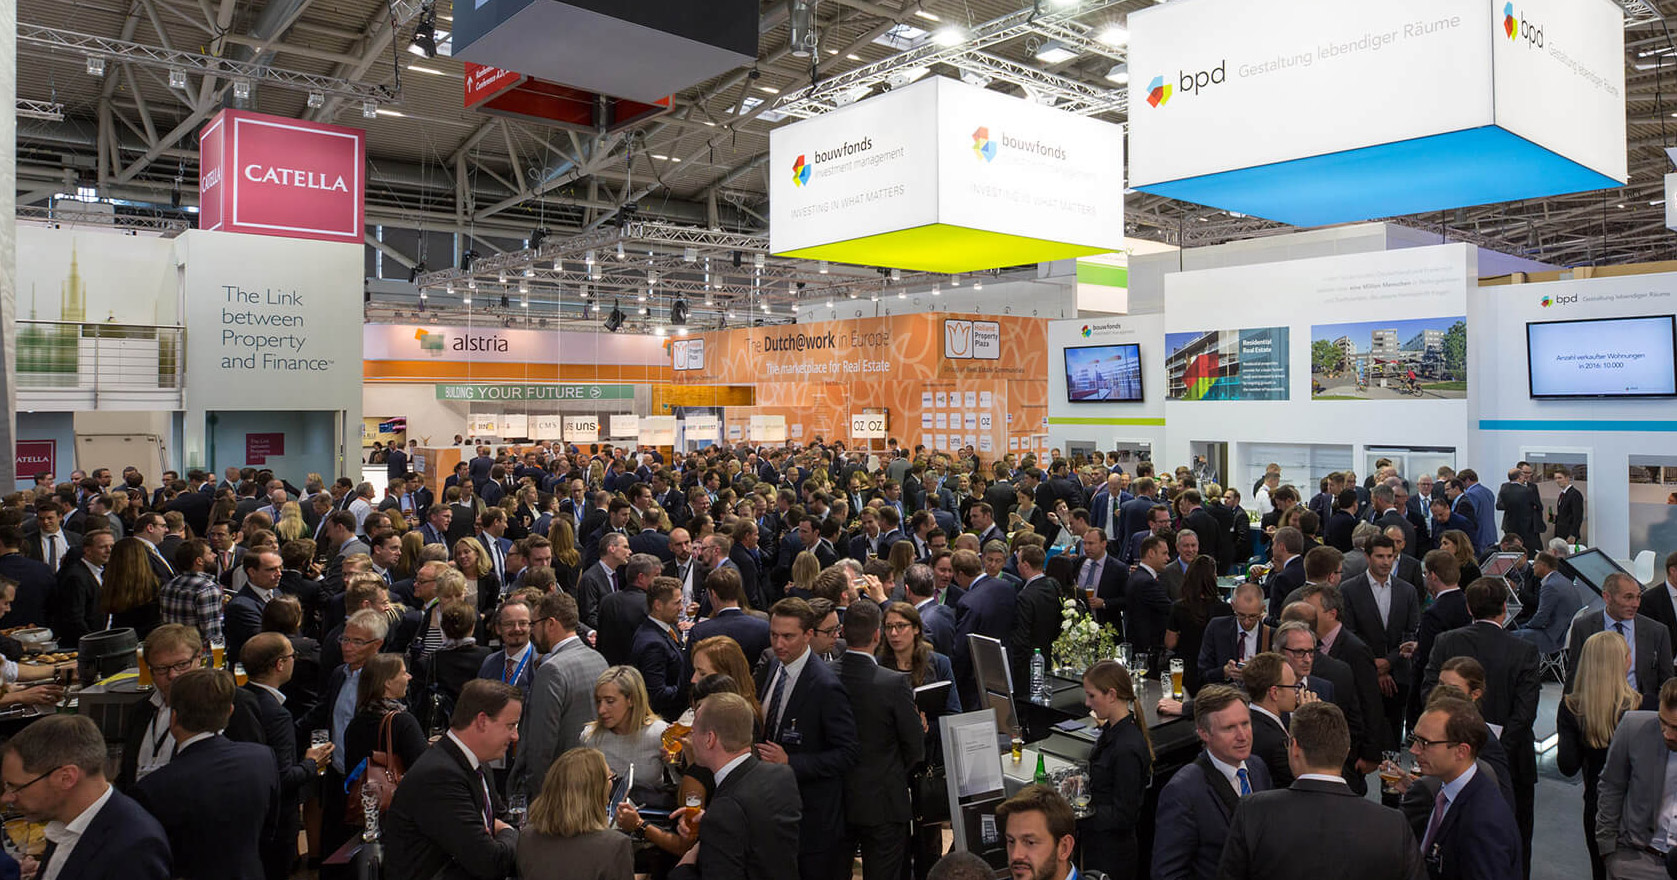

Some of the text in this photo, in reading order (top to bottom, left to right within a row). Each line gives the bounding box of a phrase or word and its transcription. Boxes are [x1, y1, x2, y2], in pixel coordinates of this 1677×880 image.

[1521, 10, 1544, 50] bpd
[1180, 13, 1461, 96] bpd Gestaltung lebendiger Räume
[815, 136, 873, 164] bouwfonds
[1002, 132, 1067, 160] bouwfonds
[815, 147, 904, 179] investment management
[202, 166, 221, 193] CATELLA
[245, 164, 349, 193] CATELLA
[791, 184, 905, 218] INVESTING IN WHAT MATTERS
[222, 285, 303, 306] The Link
[1556, 294, 1578, 305] bpd
[222, 307, 304, 327] between
[1093, 323, 1121, 331] bouwfonds
[222, 329, 306, 353] Property
[453, 334, 508, 352] alstria
[745, 329, 889, 354] The Dutch@work in Europe
[975, 332, 998, 341] Property
[221, 353, 256, 369] and
[766, 358, 891, 374] The marketplace for Real Estate
[1577, 353, 1606, 361] verkaufter
[1607, 352, 1645, 361] Wohnungen
[478, 386, 522, 399] YOUR
[527, 386, 584, 399] FUTURE
[868, 420, 883, 431] OZ
[981, 417, 991, 426] OZ
